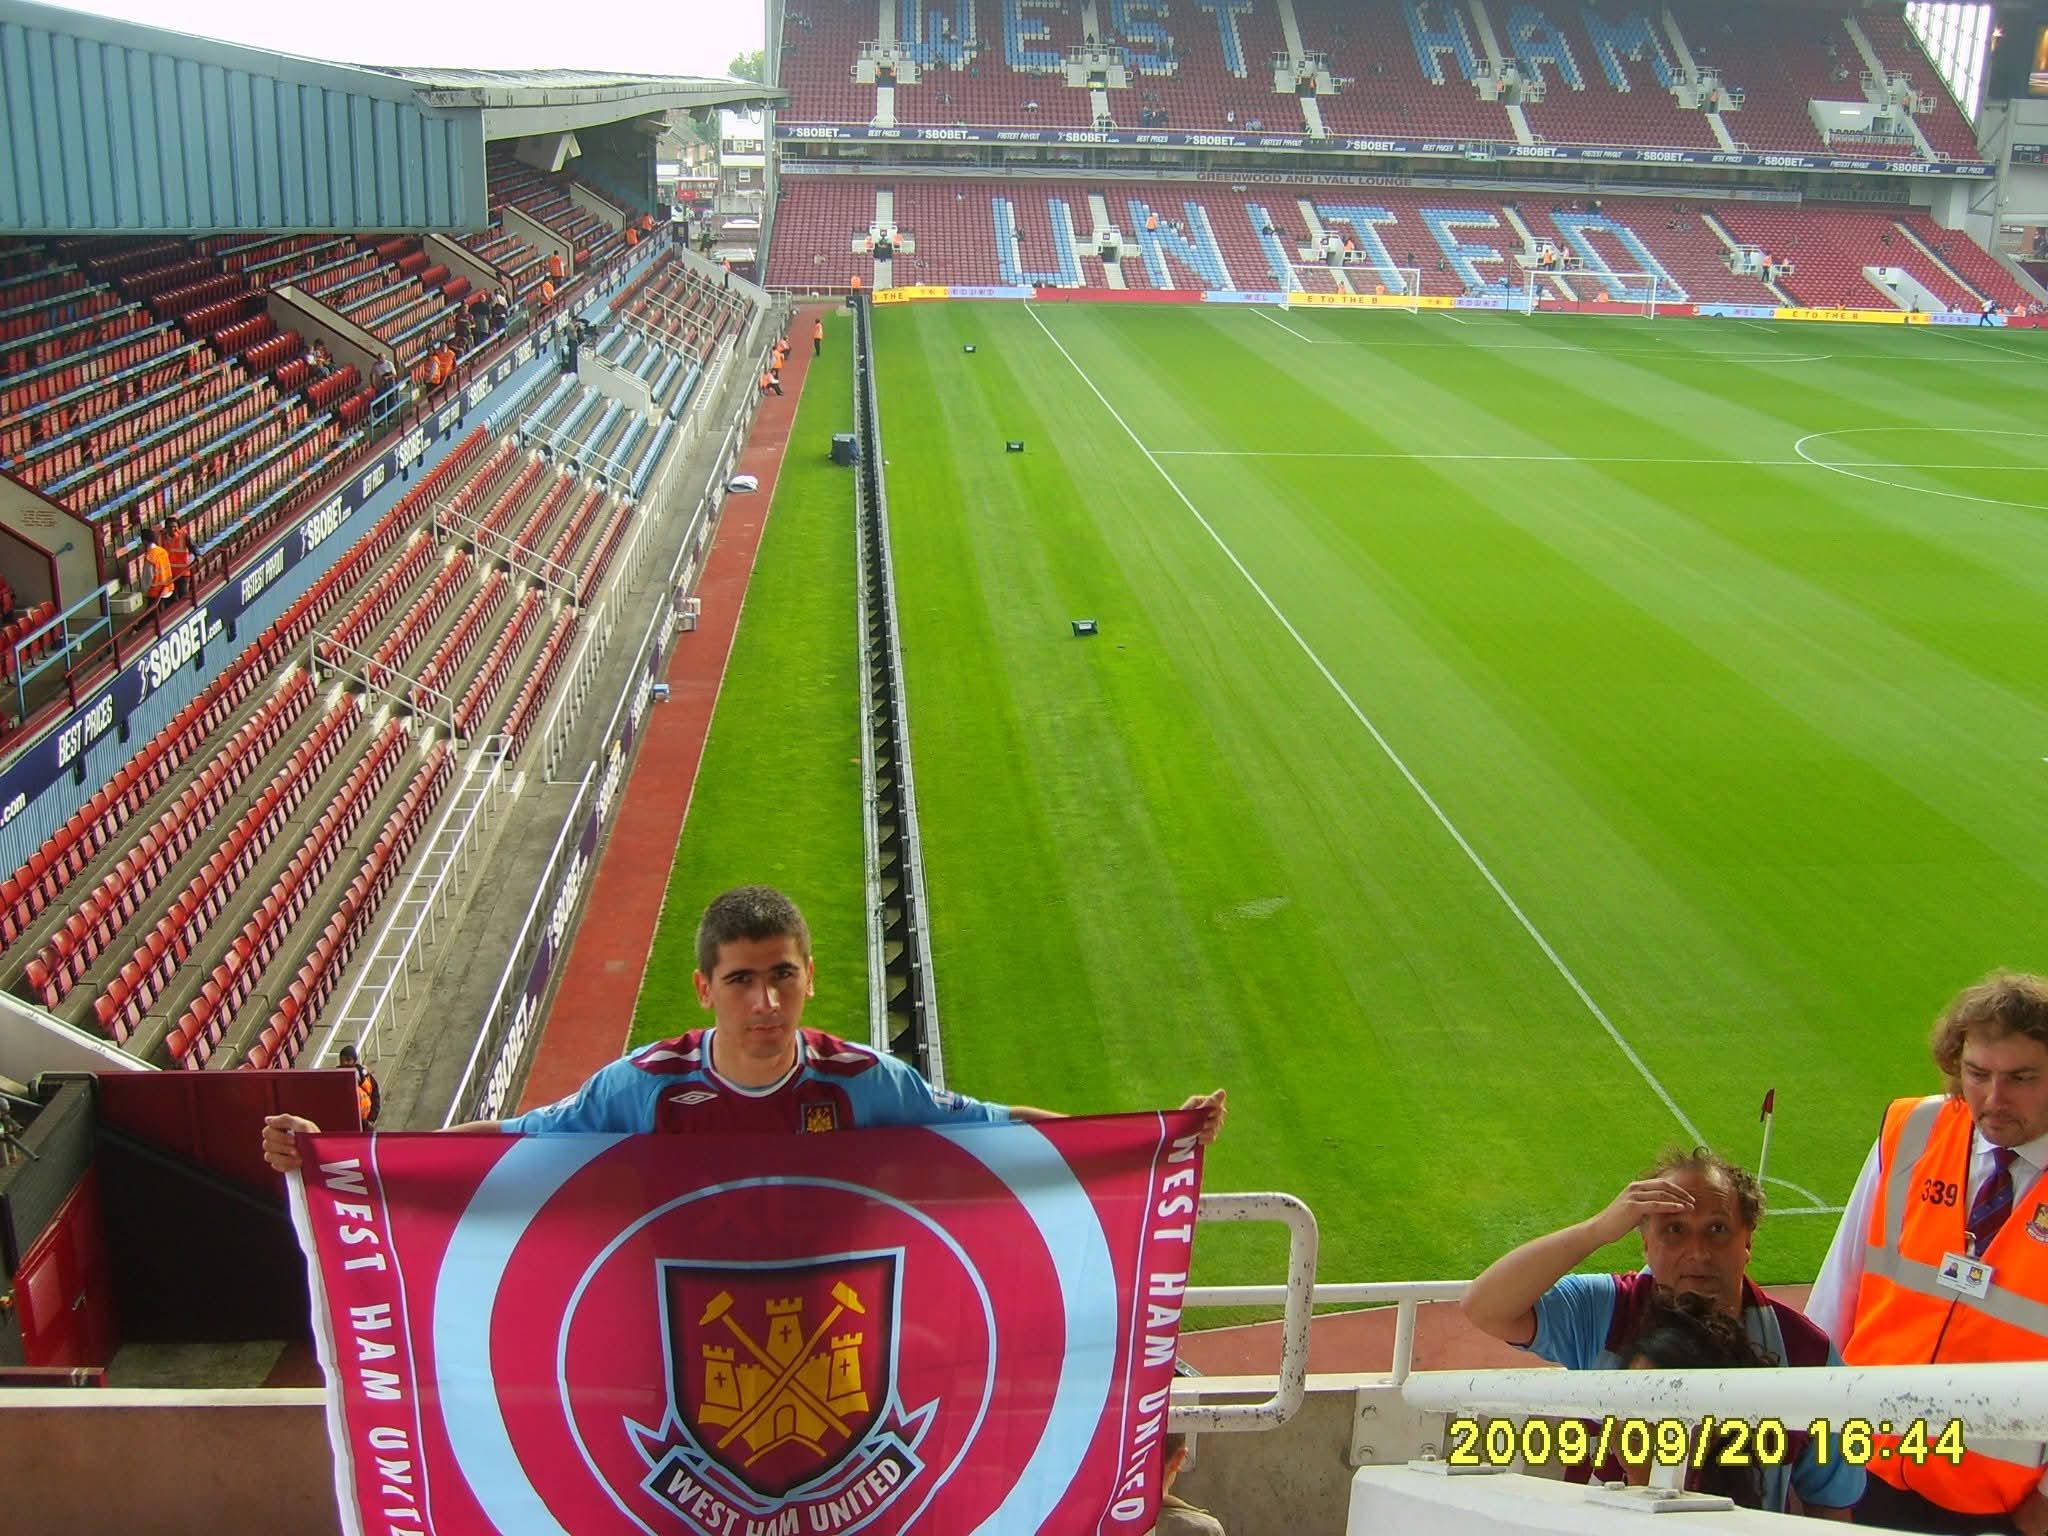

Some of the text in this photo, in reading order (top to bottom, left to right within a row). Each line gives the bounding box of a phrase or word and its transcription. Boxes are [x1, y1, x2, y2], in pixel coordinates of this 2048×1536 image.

[901, 0, 1678, 95] WEST HAM
[1197, 172, 1412, 187] GREENWOOD AND LYALL LOUNGE
[992, 198, 1690, 302] UNITED
[1826, 312, 1846, 320] THE
[150, 607, 223, 688] SBOBET.com
[59, 694, 113, 768] BEST PRICES
[319, 1158, 387, 1272] WEST
[1921, 1178, 1958, 1208] 339
[350, 1302, 402, 1401] HAM
[1143, 1271, 1186, 1368] HAM
[666, 1458, 902, 1536] WEST HAM UNITED
[1110, 1386, 1169, 1523] UNITED
